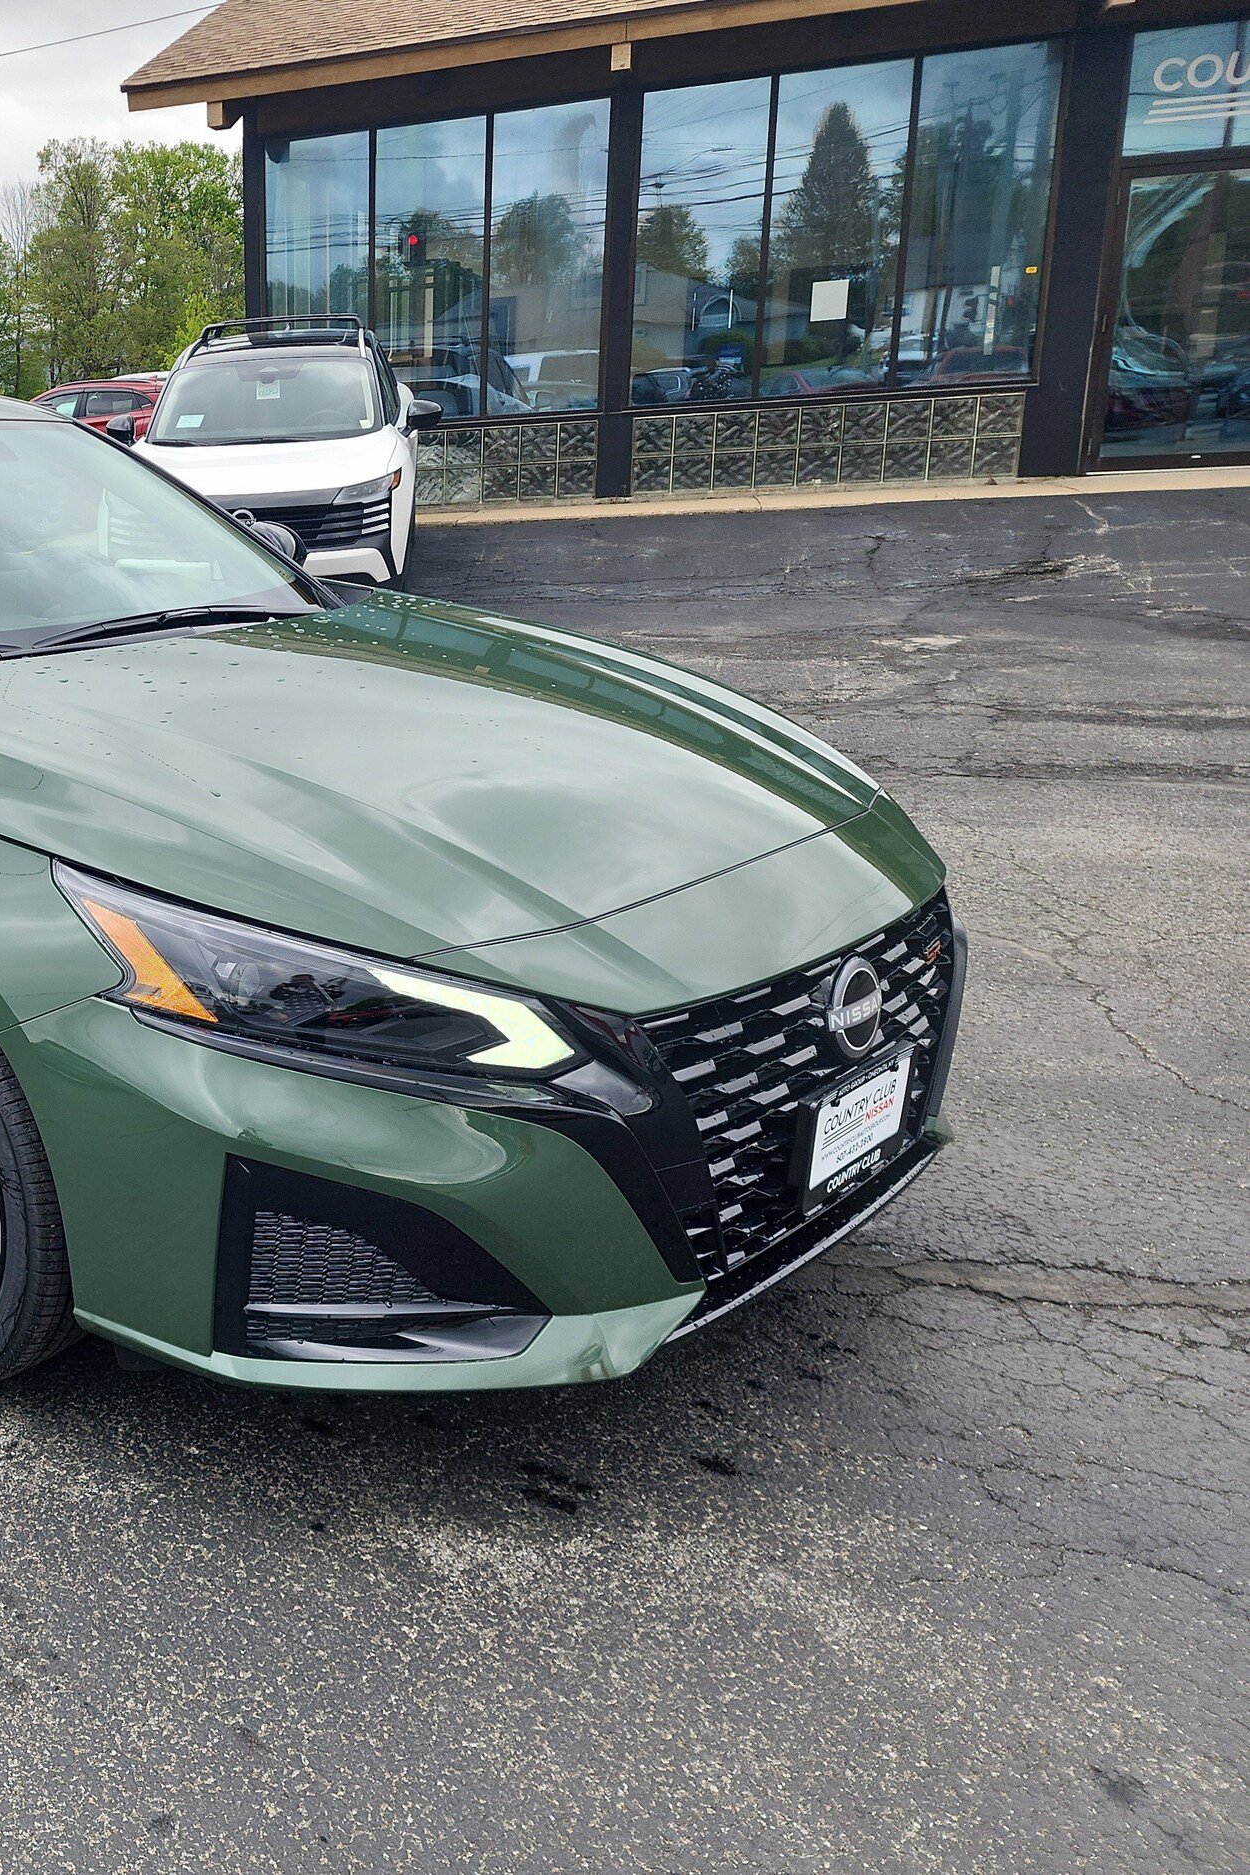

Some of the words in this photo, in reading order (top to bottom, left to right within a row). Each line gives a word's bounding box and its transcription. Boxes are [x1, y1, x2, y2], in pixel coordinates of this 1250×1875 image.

[830, 992, 882, 1029] NISSAN
[824, 1092, 873, 1135] COUNTRY
[872, 1079, 897, 1105] CLUB
[864, 1096, 895, 1122] NISSAN
[826, 1157, 864, 1194] COUNTRY
[861, 1148, 882, 1170] CLUB
